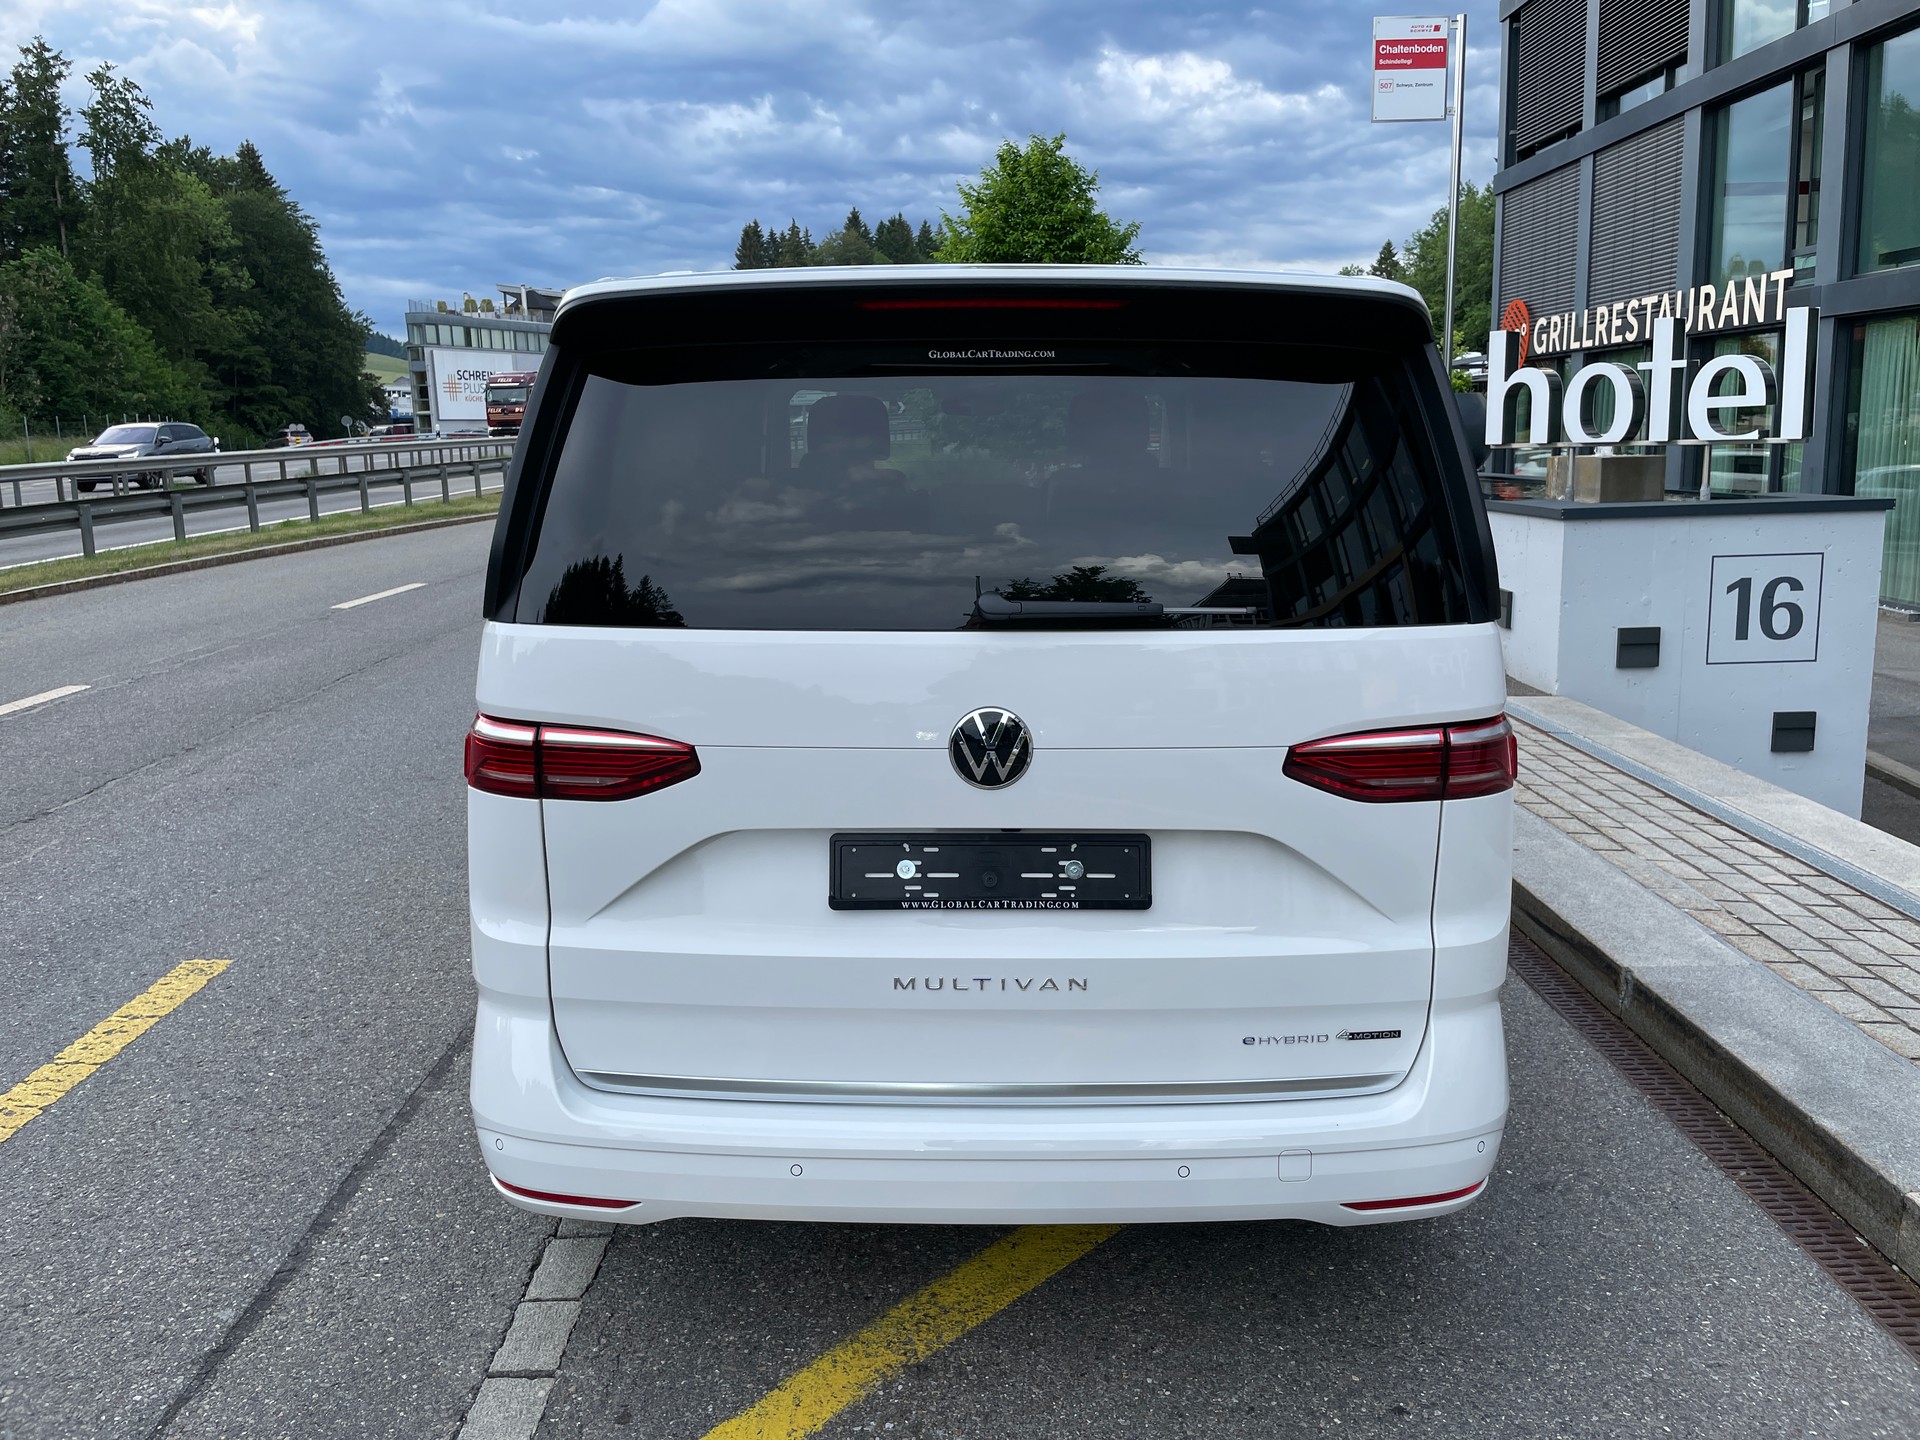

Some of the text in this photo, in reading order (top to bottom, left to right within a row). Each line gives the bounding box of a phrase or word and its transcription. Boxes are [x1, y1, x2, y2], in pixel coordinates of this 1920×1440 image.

[1379, 43, 1444, 54] Chaltenboden
[1533, 268, 1794, 355] GRILLRESTAURANT
[1485, 306, 1820, 446] hotel
[1725, 576, 1805, 641] 16
[893, 976, 1089, 991] MULTIVAN
[1242, 1034, 1329, 1046] eHYBRID
